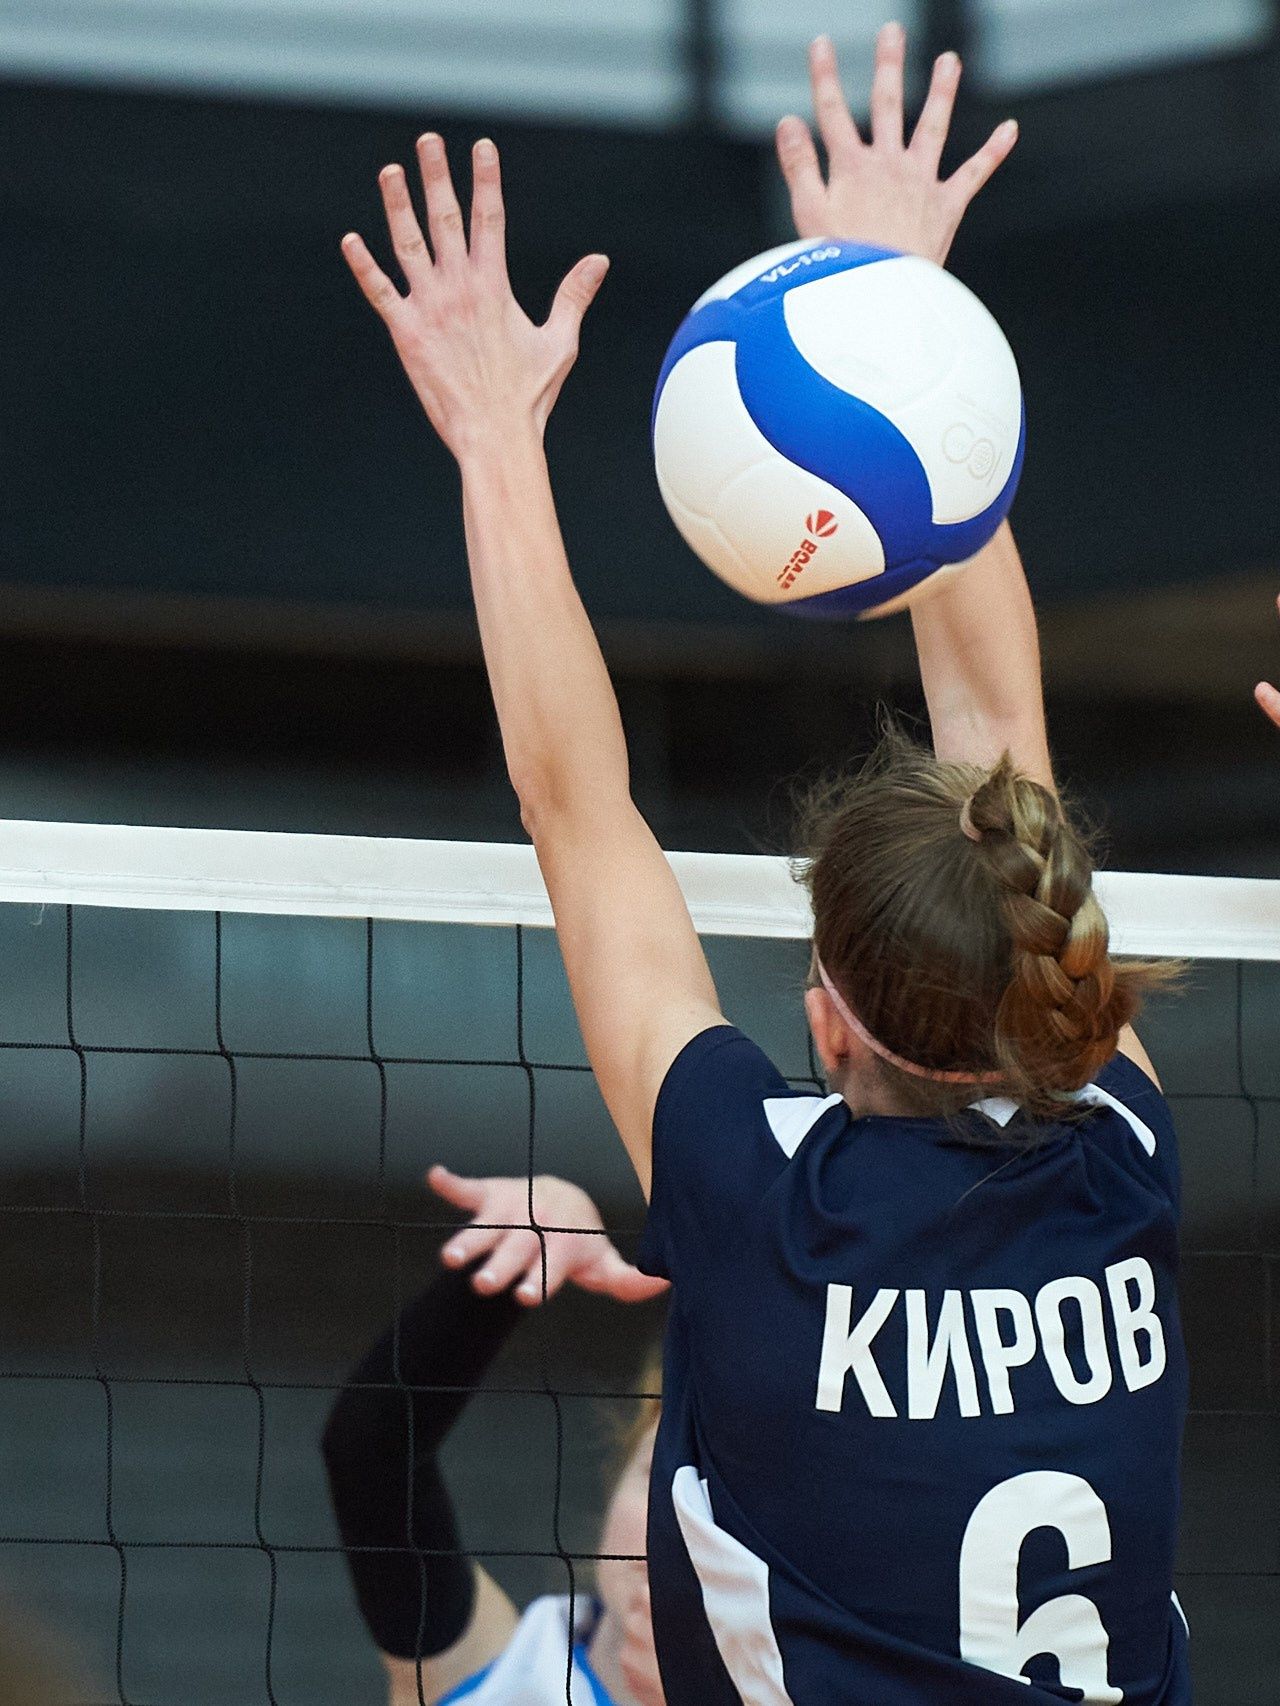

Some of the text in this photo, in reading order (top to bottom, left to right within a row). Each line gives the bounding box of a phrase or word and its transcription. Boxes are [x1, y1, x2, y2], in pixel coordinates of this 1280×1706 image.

[760, 246, 841, 282] VL-100
[815, 1257, 1167, 1420] КИРОВ
[959, 1470, 1124, 1704] 6
